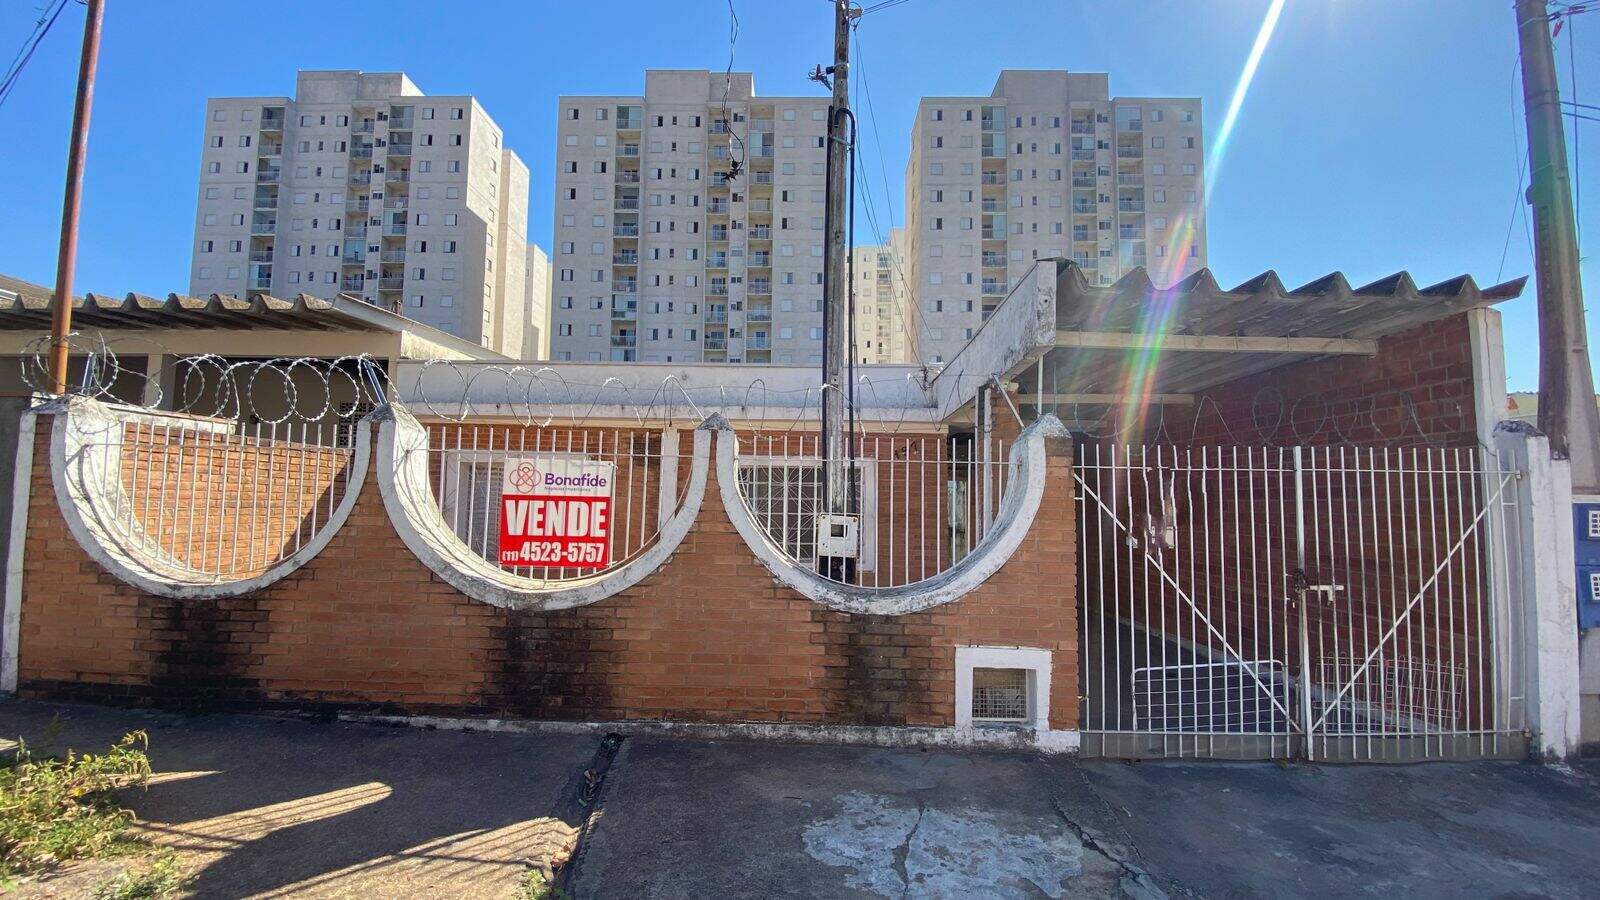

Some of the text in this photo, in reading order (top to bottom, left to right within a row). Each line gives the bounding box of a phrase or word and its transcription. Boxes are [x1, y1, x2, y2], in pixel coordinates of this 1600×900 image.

[544, 472, 607, 487] Bonafide
[505, 499, 607, 538] VENDE
[502, 541, 604, 563] (11) 4523-5757
